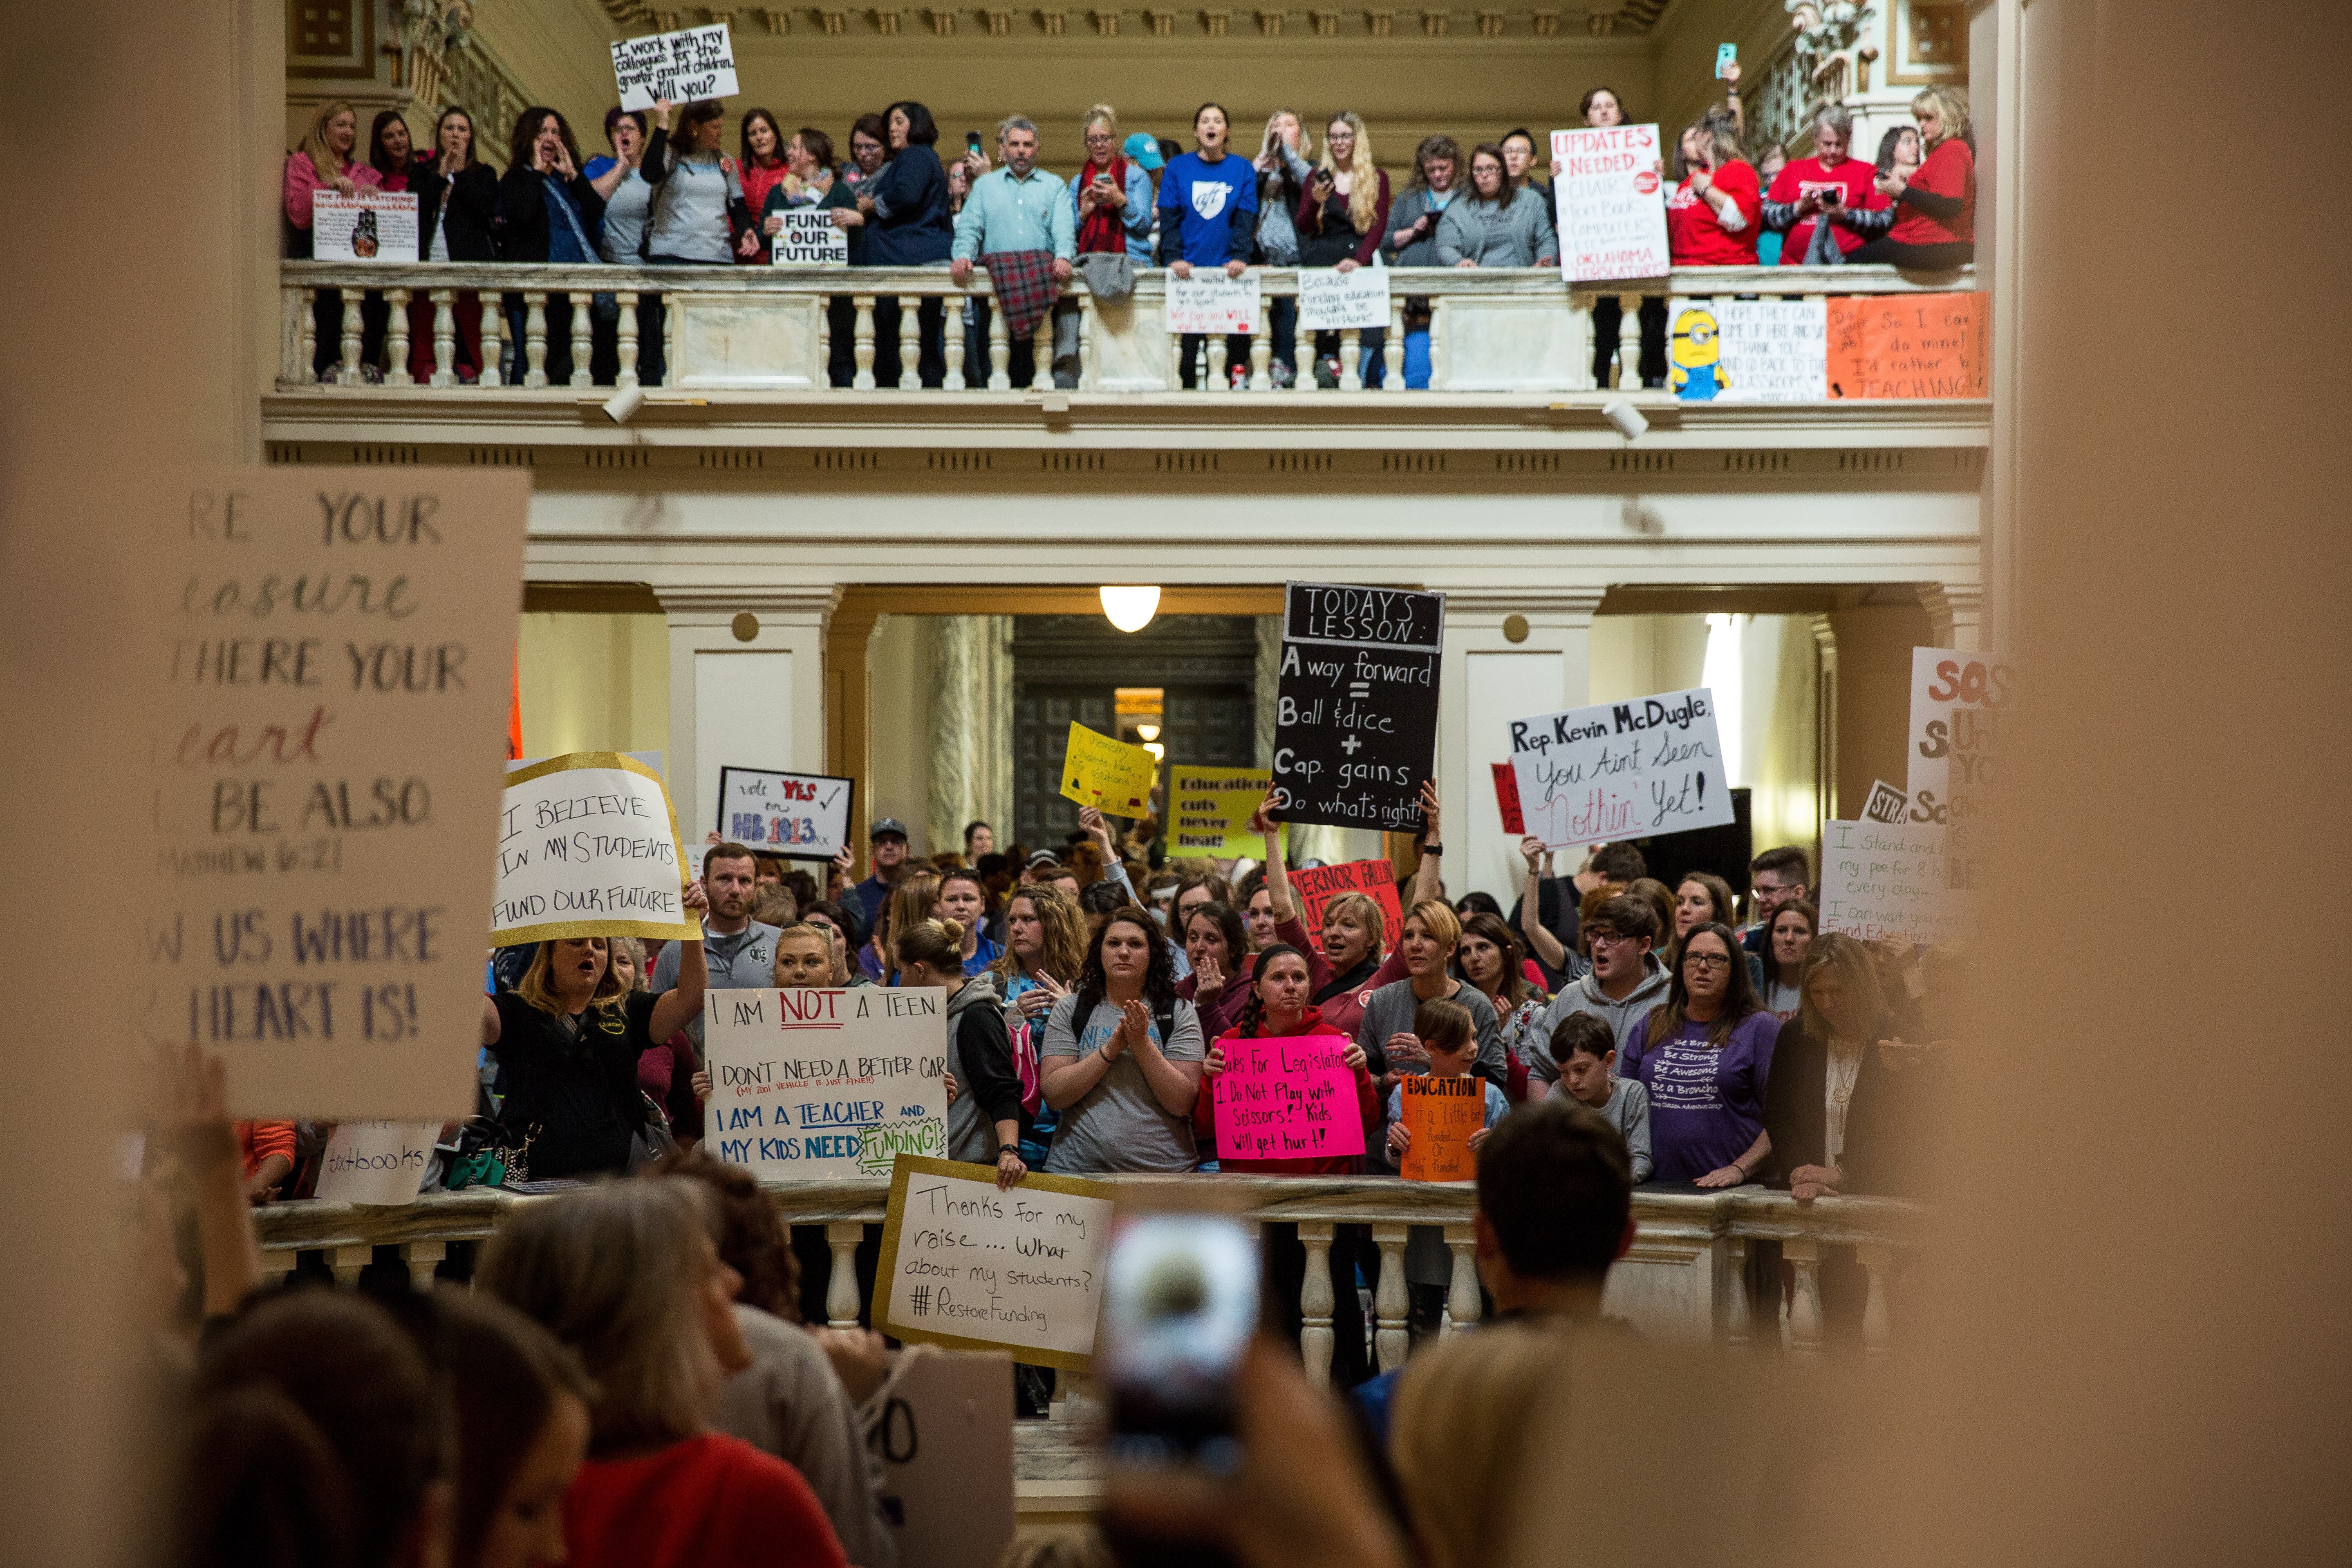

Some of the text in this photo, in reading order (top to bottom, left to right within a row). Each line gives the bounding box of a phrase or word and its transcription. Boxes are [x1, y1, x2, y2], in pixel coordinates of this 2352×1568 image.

[612, 30, 723, 59] I work with my
[672, 49, 691, 65] for
[696, 45, 721, 57] the
[645, 74, 715, 103] Will you?
[1554, 128, 1653, 155] UPDATES
[786, 215, 832, 228] FUND
[791, 231, 828, 244] OUR
[775, 248, 845, 260] FUTURE
[1881, 308, 1927, 330] So I
[1890, 335, 1910, 353] do
[1891, 354, 1942, 372] rather
[317, 492, 443, 545] YOUR
[1305, 589, 1415, 623] TODAY'S
[1309, 616, 1427, 642] LESSON:
[346, 639, 468, 693] YOUR
[1280, 646, 1432, 687] A way forward
[1278, 696, 1323, 726] Ball
[1343, 702, 1394, 733] dice
[1510, 695, 1711, 755] Rep. Kevin McDugle,
[1274, 748, 1411, 788] Cap. gains
[1536, 760, 1582, 803] You
[1651, 730, 1713, 767] Seen
[739, 779, 816, 802] vote YES
[1180, 777, 1268, 791] Education
[211, 778, 281, 832] BE
[304, 775, 432, 831] ALSO
[765, 801, 791, 813] on
[1180, 800, 1216, 811] cuts
[1272, 787, 1306, 810] Do
[1318, 793, 1377, 818] what's
[1652, 771, 1705, 827] Yet!
[500, 795, 651, 843] I BELIEVE
[732, 813, 765, 841] HB
[1180, 818, 1227, 829] never
[1833, 826, 1854, 850] I
[1909, 837, 1935, 854] and
[497, 831, 674, 879] IN MY STUDENTS
[1839, 860, 1860, 877] my
[1869, 861, 1888, 877] pee
[1892, 860, 1911, 875] for
[1917, 861, 1926, 877] 8
[1289, 866, 1358, 897] VERNOR
[1846, 881, 1886, 900] every
[492, 886, 676, 927] FUND OUR FUTURE
[1828, 900, 1847, 916] I
[1875, 909, 1904, 923] wait
[214, 908, 273, 968] US
[292, 904, 445, 964] WHERE
[188, 978, 420, 1043] HEART IS!
[712, 994, 719, 1024] I
[734, 1000, 763, 1027] AM
[779, 990, 846, 1022] NOT
[856, 995, 869, 1018] A
[1252, 1047, 1346, 1082] For Legislator
[1653, 1064, 1719, 1076] Be Awesome
[1664, 1051, 1719, 1063] Be Strong
[709, 1060, 714, 1089] I
[784, 1059, 833, 1079] NEED
[837, 1060, 850, 1078] A
[858, 1057, 915, 1077] BETTER
[920, 1056, 945, 1077] CAR
[756, 1085, 772, 1095] 2001
[777, 1080, 809, 1091] VEHICLE
[825, 1078, 842, 1086] JUST
[1216, 1080, 1336, 1111] 1. Do Not Play with
[1407, 1077, 1478, 1097] EDUCATION
[1650, 1081, 1719, 1095] Be a Broncho
[716, 1100, 925, 1131] I AM A TEACHER AND
[1305, 1102, 1332, 1122] Kids
[721, 1122, 940, 1163] MY KIDS NEED FUNDING!
[1231, 1133, 1252, 1151] Will
[1256, 1133, 1277, 1158] get
[1432, 1143, 1444, 1157] Or
[1432, 1156, 1460, 1173] funded
[915, 1185, 1086, 1240] Thanks my
[1016, 1236, 1069, 1260] What
[905, 1258, 1093, 1295] about my students?
[909, 1284, 1047, 1331] #RestoreFunding
